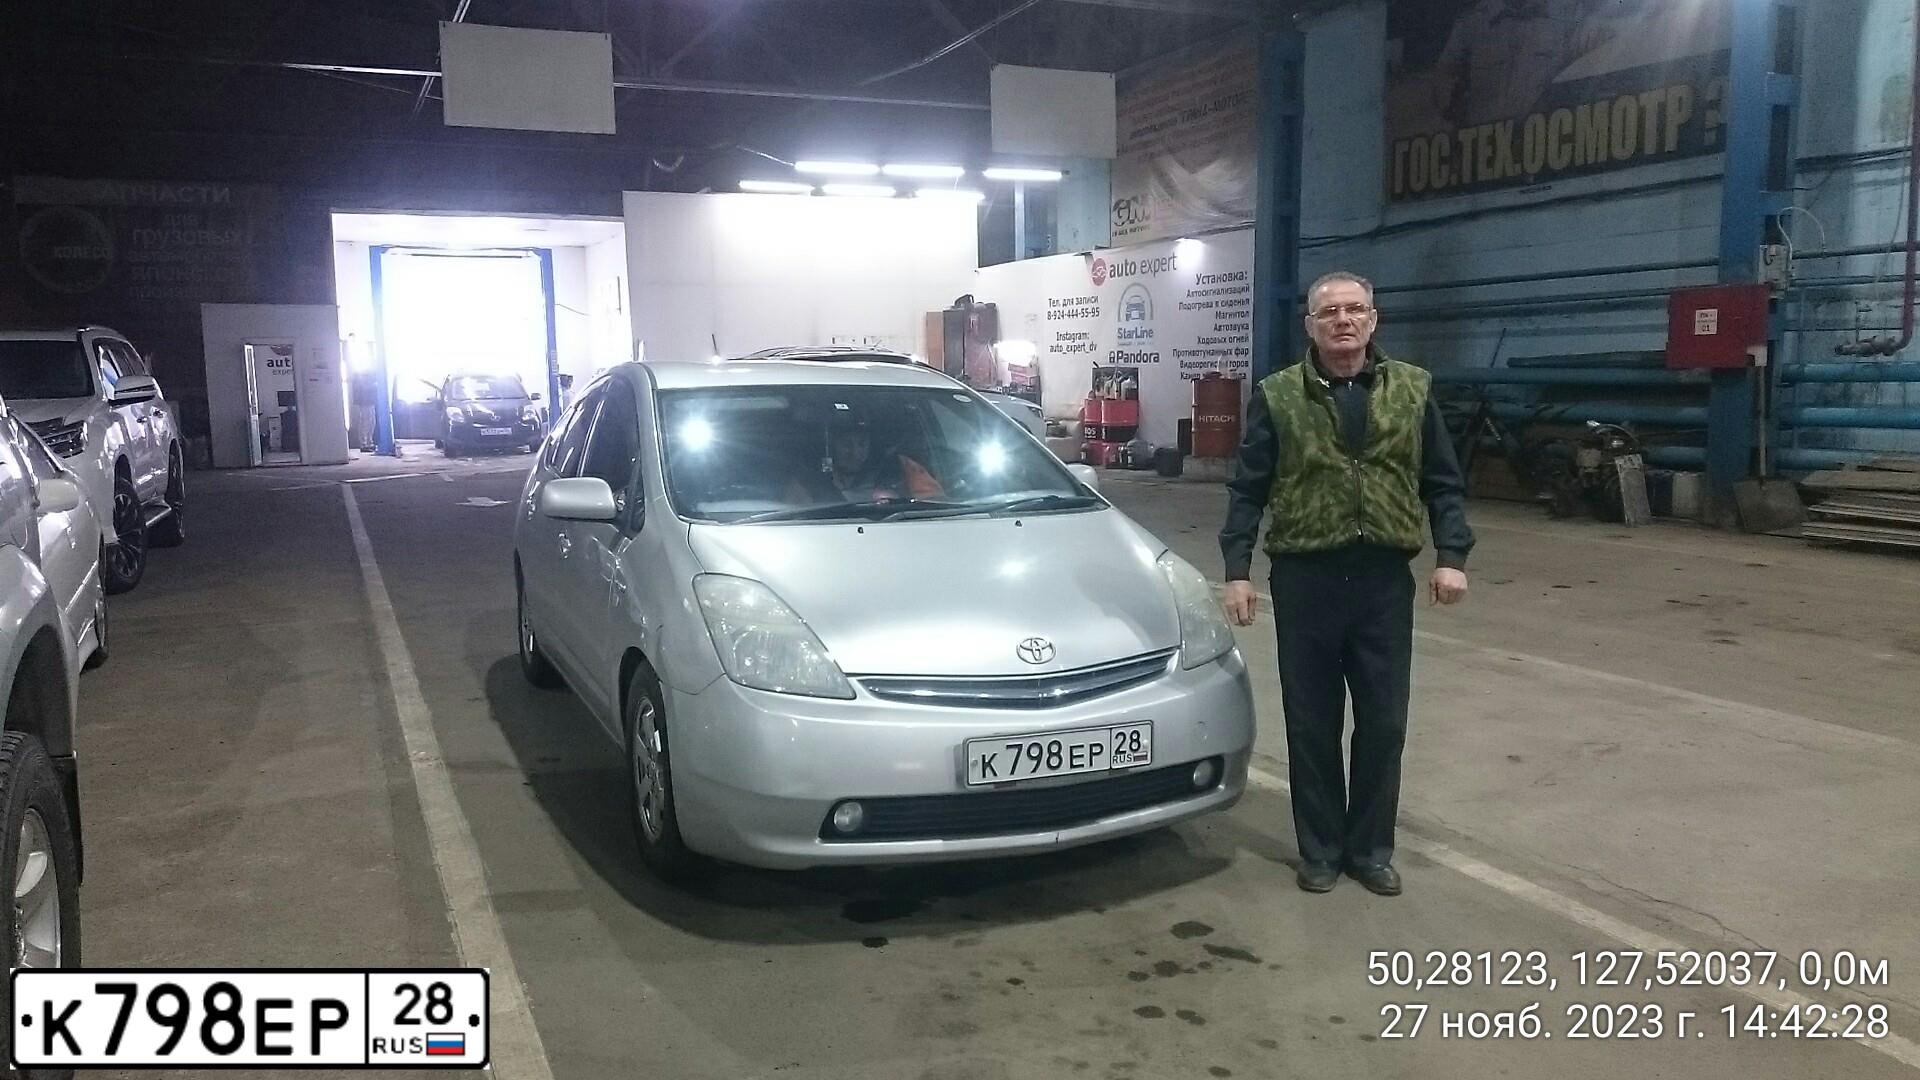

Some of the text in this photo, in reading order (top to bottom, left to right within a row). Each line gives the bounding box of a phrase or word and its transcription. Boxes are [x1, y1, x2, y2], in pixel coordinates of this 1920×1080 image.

[1393, 85, 1692, 194] ГОС.ТЕХ.ОСМОТР
[88, 184, 231, 204] АПЧАСТИ
[1109, 252, 1177, 279] auto expert
[1195, 271, 1248, 286] Установка:
[1075, 295, 1099, 305] записи
[1047, 306, 1100, 321] 8-924-444-55-95
[1056, 331, 1090, 343] Instagram:
[1117, 325, 1154, 340] StarLine
[1116, 350, 1160, 364] Pandora
[1234, 345, 1249, 357] фар
[266, 357, 293, 368] aut
[1199, 415, 1236, 423] HITACHI
[1114, 730, 1142, 755] 28
[1112, 753, 1133, 764] RUS
